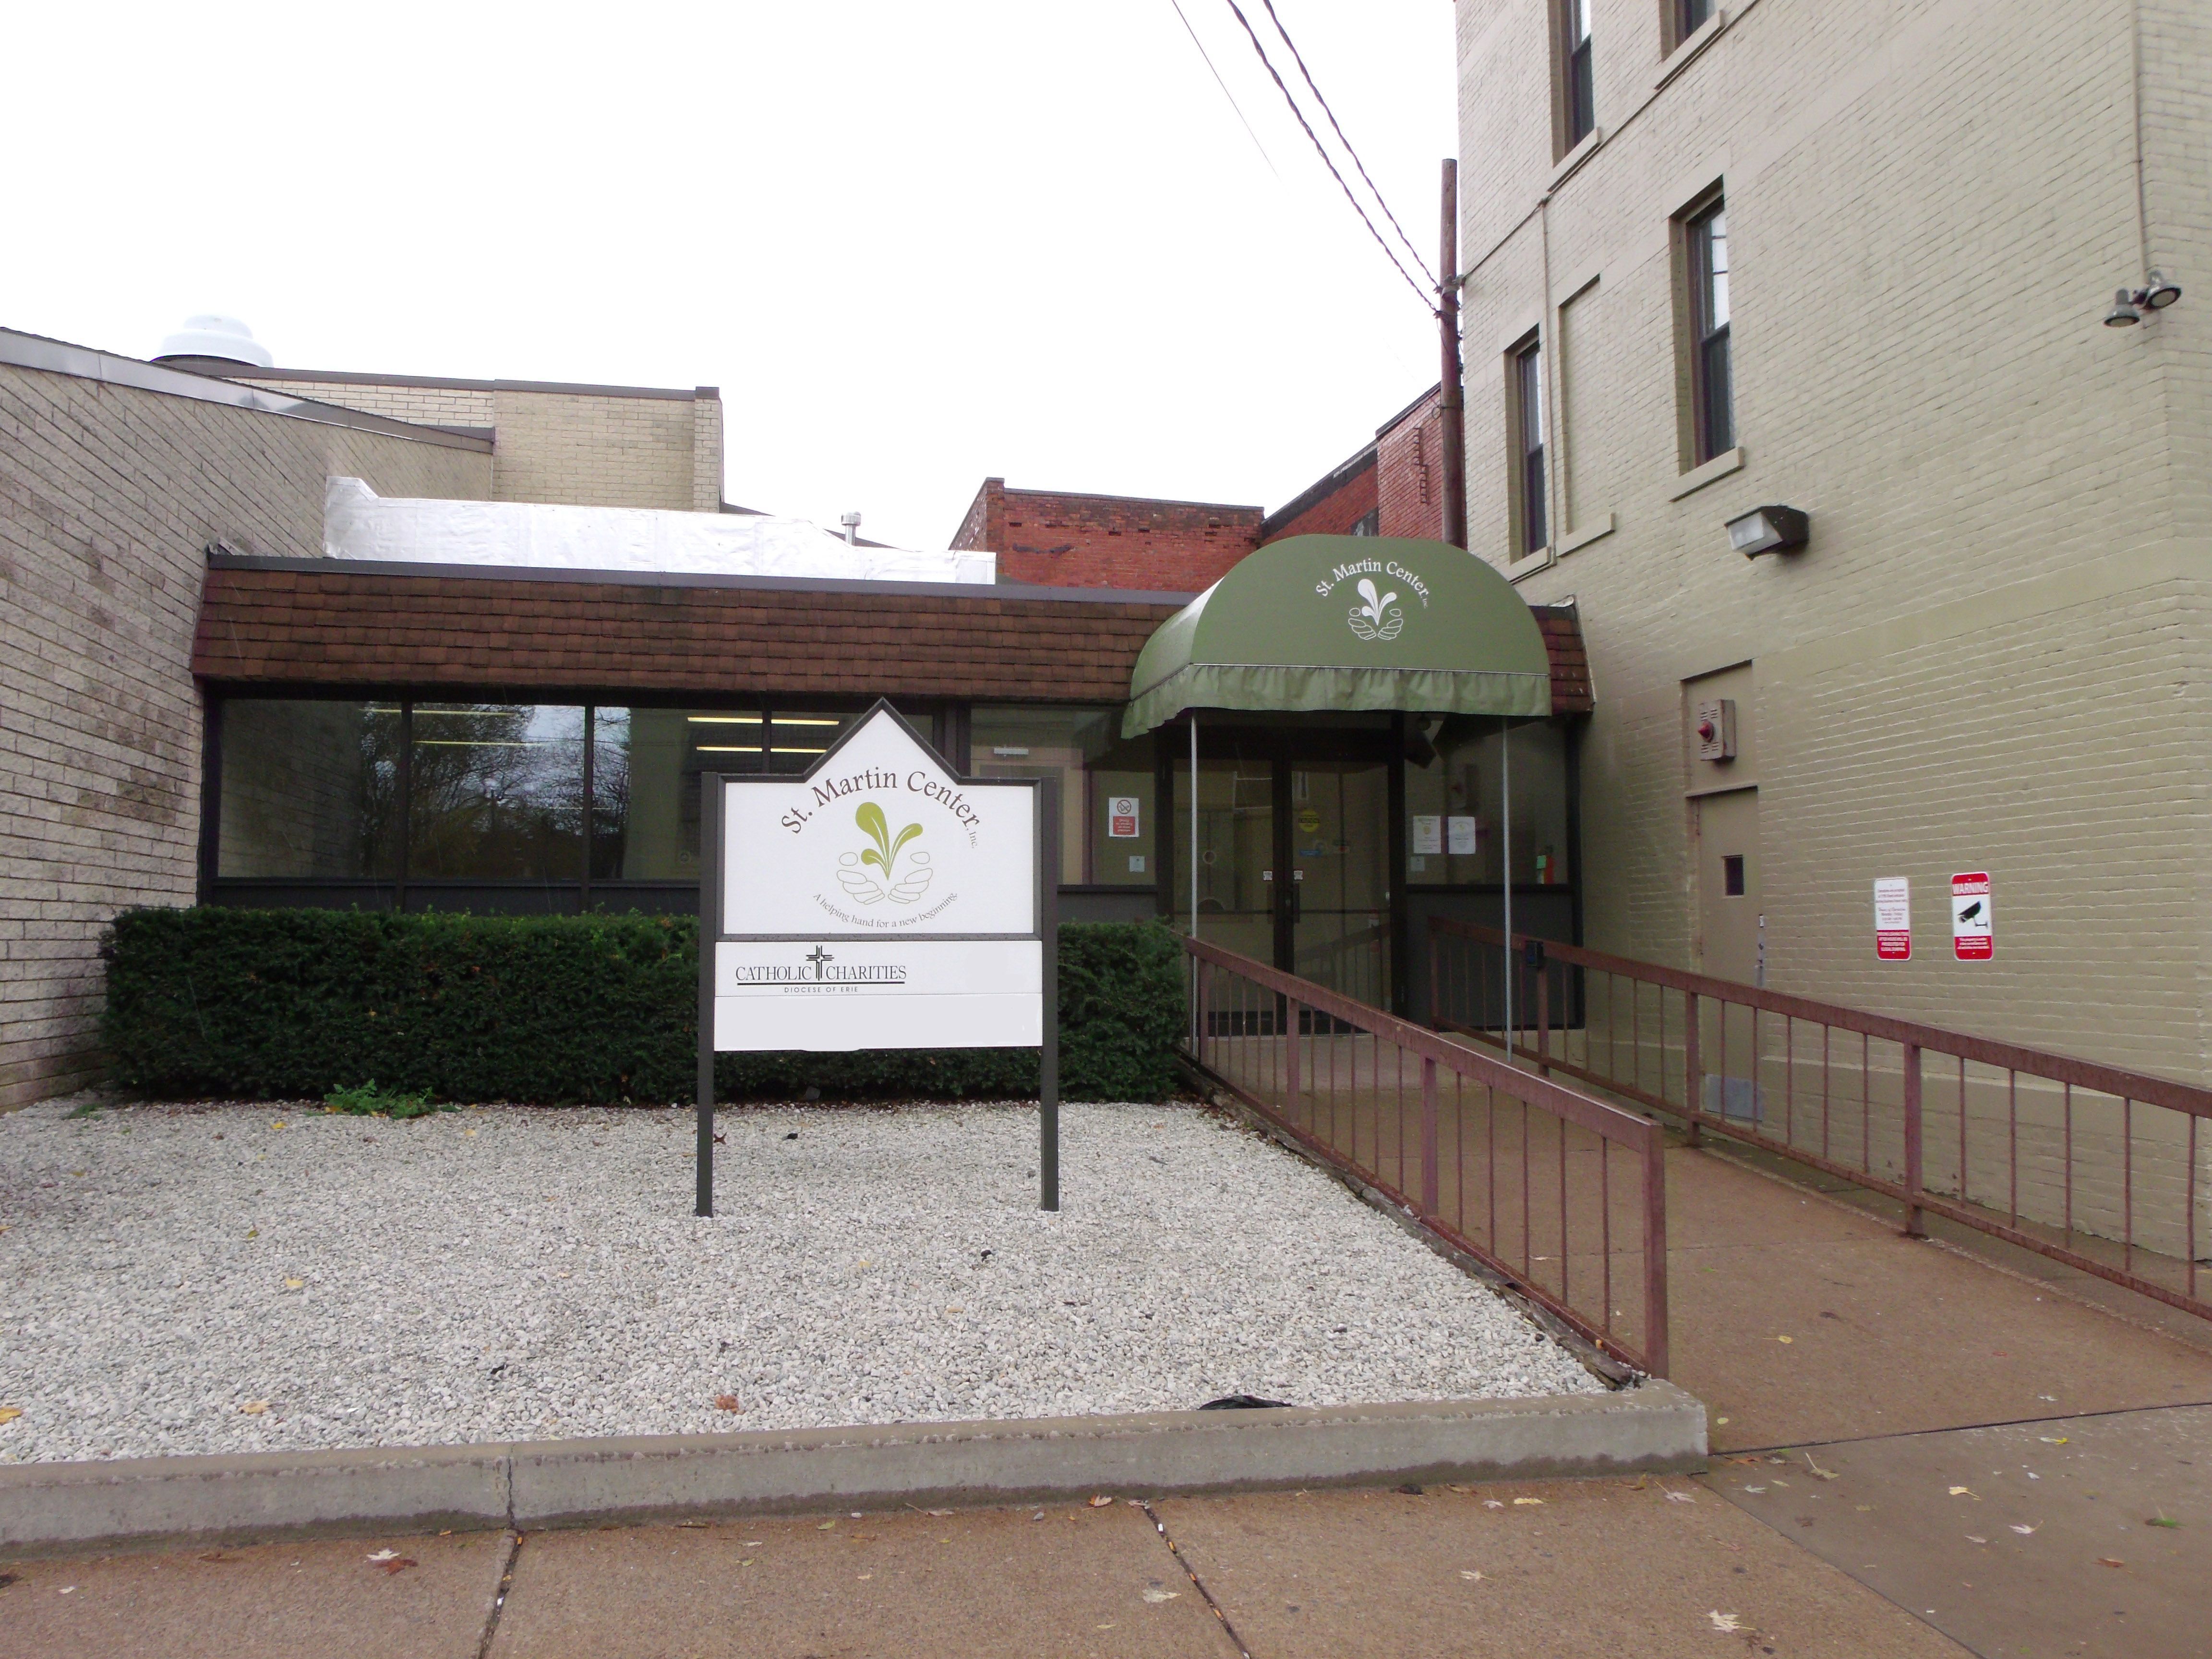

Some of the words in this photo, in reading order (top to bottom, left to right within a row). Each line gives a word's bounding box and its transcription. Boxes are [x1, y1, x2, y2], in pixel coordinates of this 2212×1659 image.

[1316, 580, 1334, 597] St.
[1333, 557, 1382, 582] Martin
[781, 806, 813, 834] St.
[811, 766, 898, 807] Martin
[907, 771, 980, 831] Center,
[1952, 882, 1989, 895] WARNING
[813, 893, 821, 902] A
[820, 898, 850, 923] helping
[851, 914, 874, 927] hand
[877, 919, 889, 928] for
[899, 916, 917, 927] new
[919, 892, 958, 921] beginning.
[735, 965, 812, 981] CATHOLIC
[826, 965, 907, 980] CHARITIES
